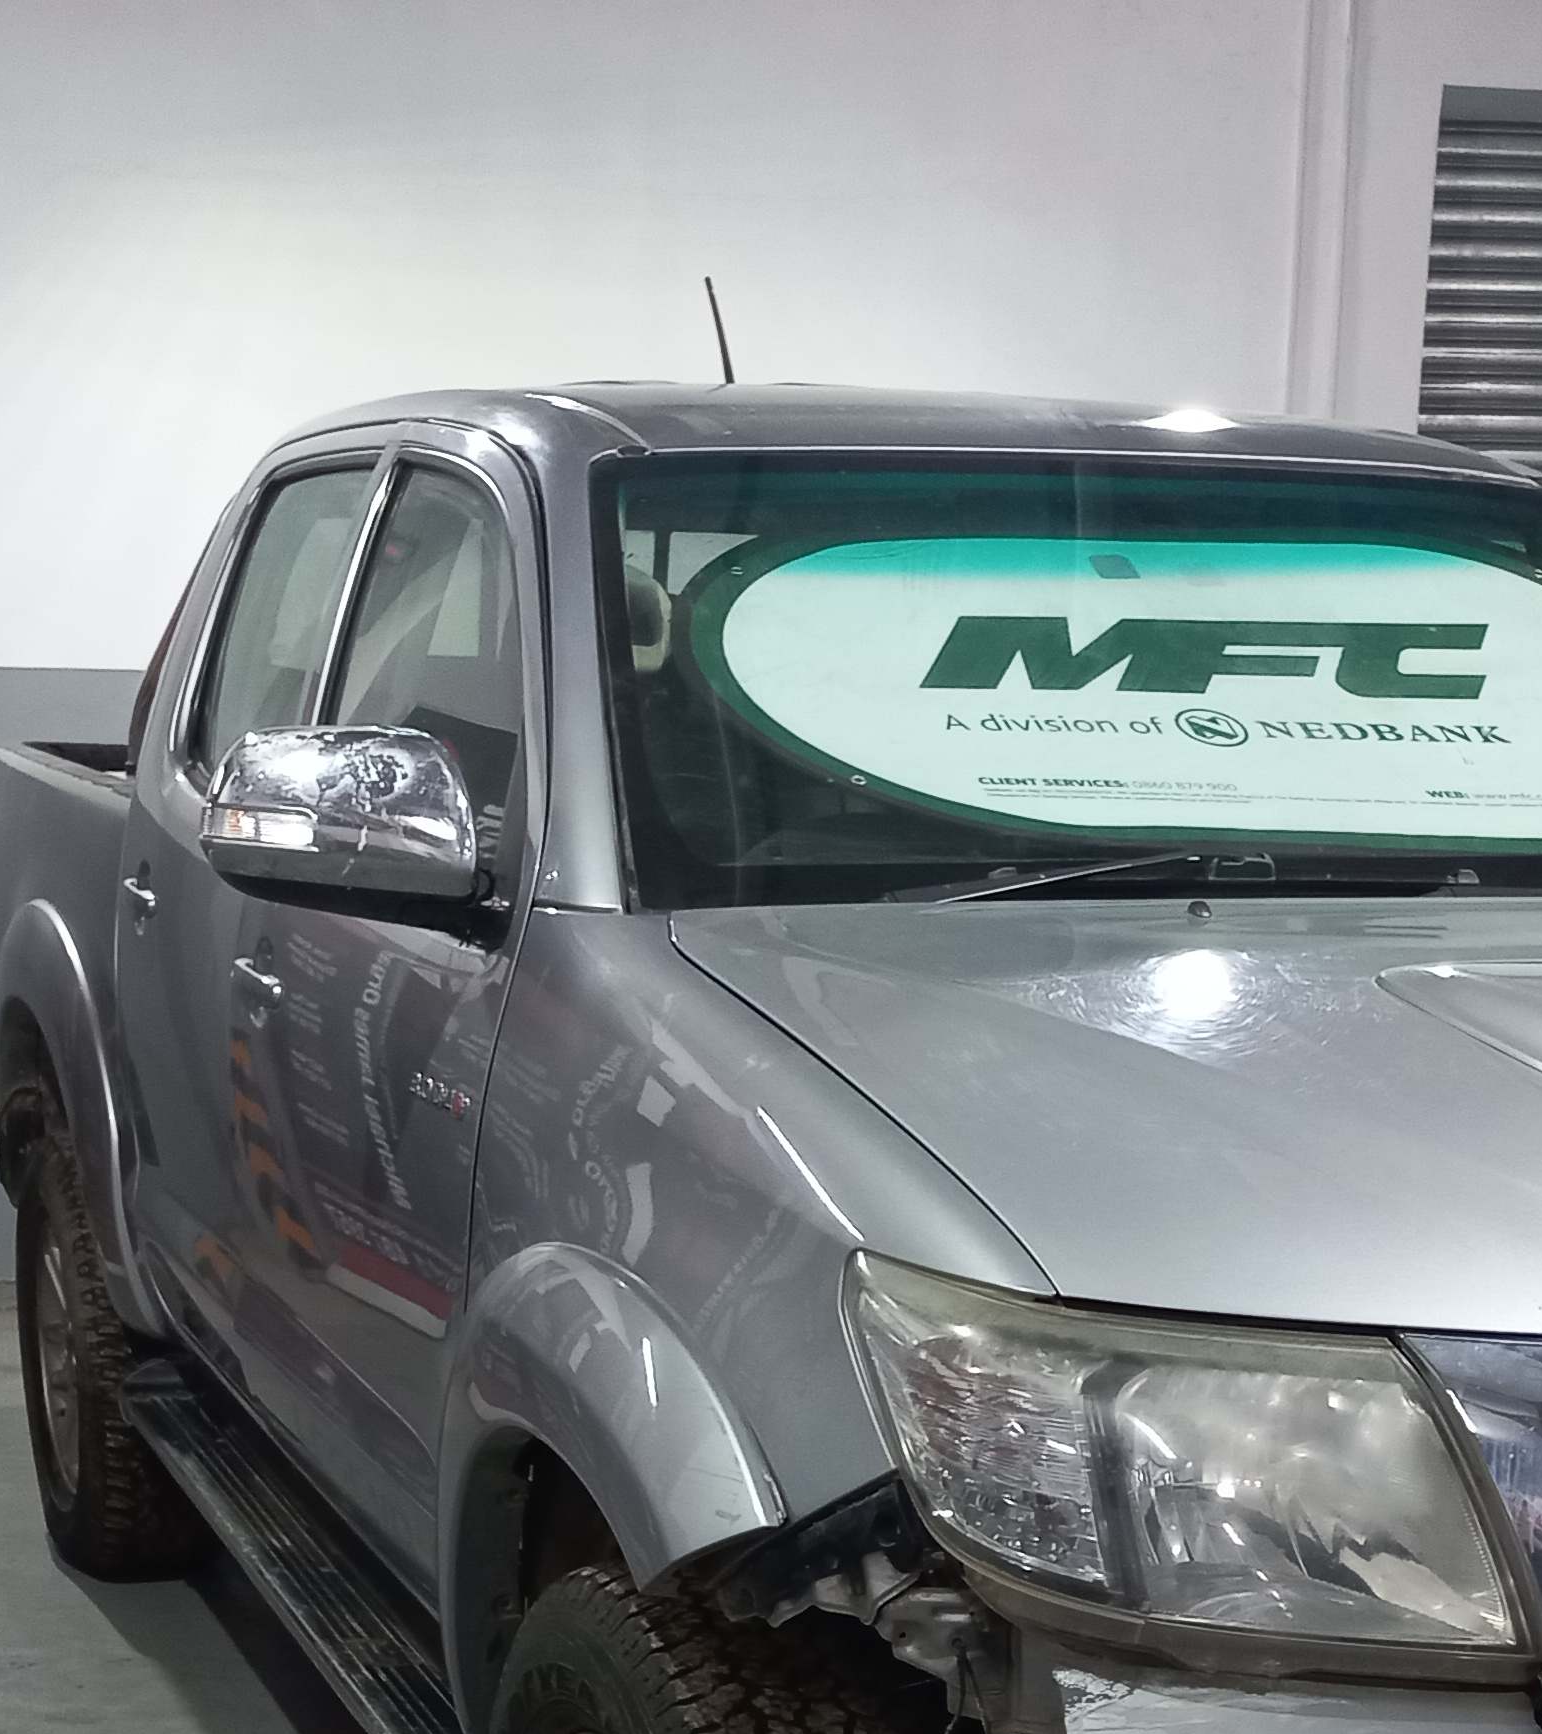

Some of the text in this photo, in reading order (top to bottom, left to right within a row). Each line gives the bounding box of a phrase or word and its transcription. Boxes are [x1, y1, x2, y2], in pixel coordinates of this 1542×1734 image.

[919, 615, 1489, 700] MFC
[945, 711, 1512, 745] A division of NEDBANK
[977, 776, 1036, 786] CLIENT
